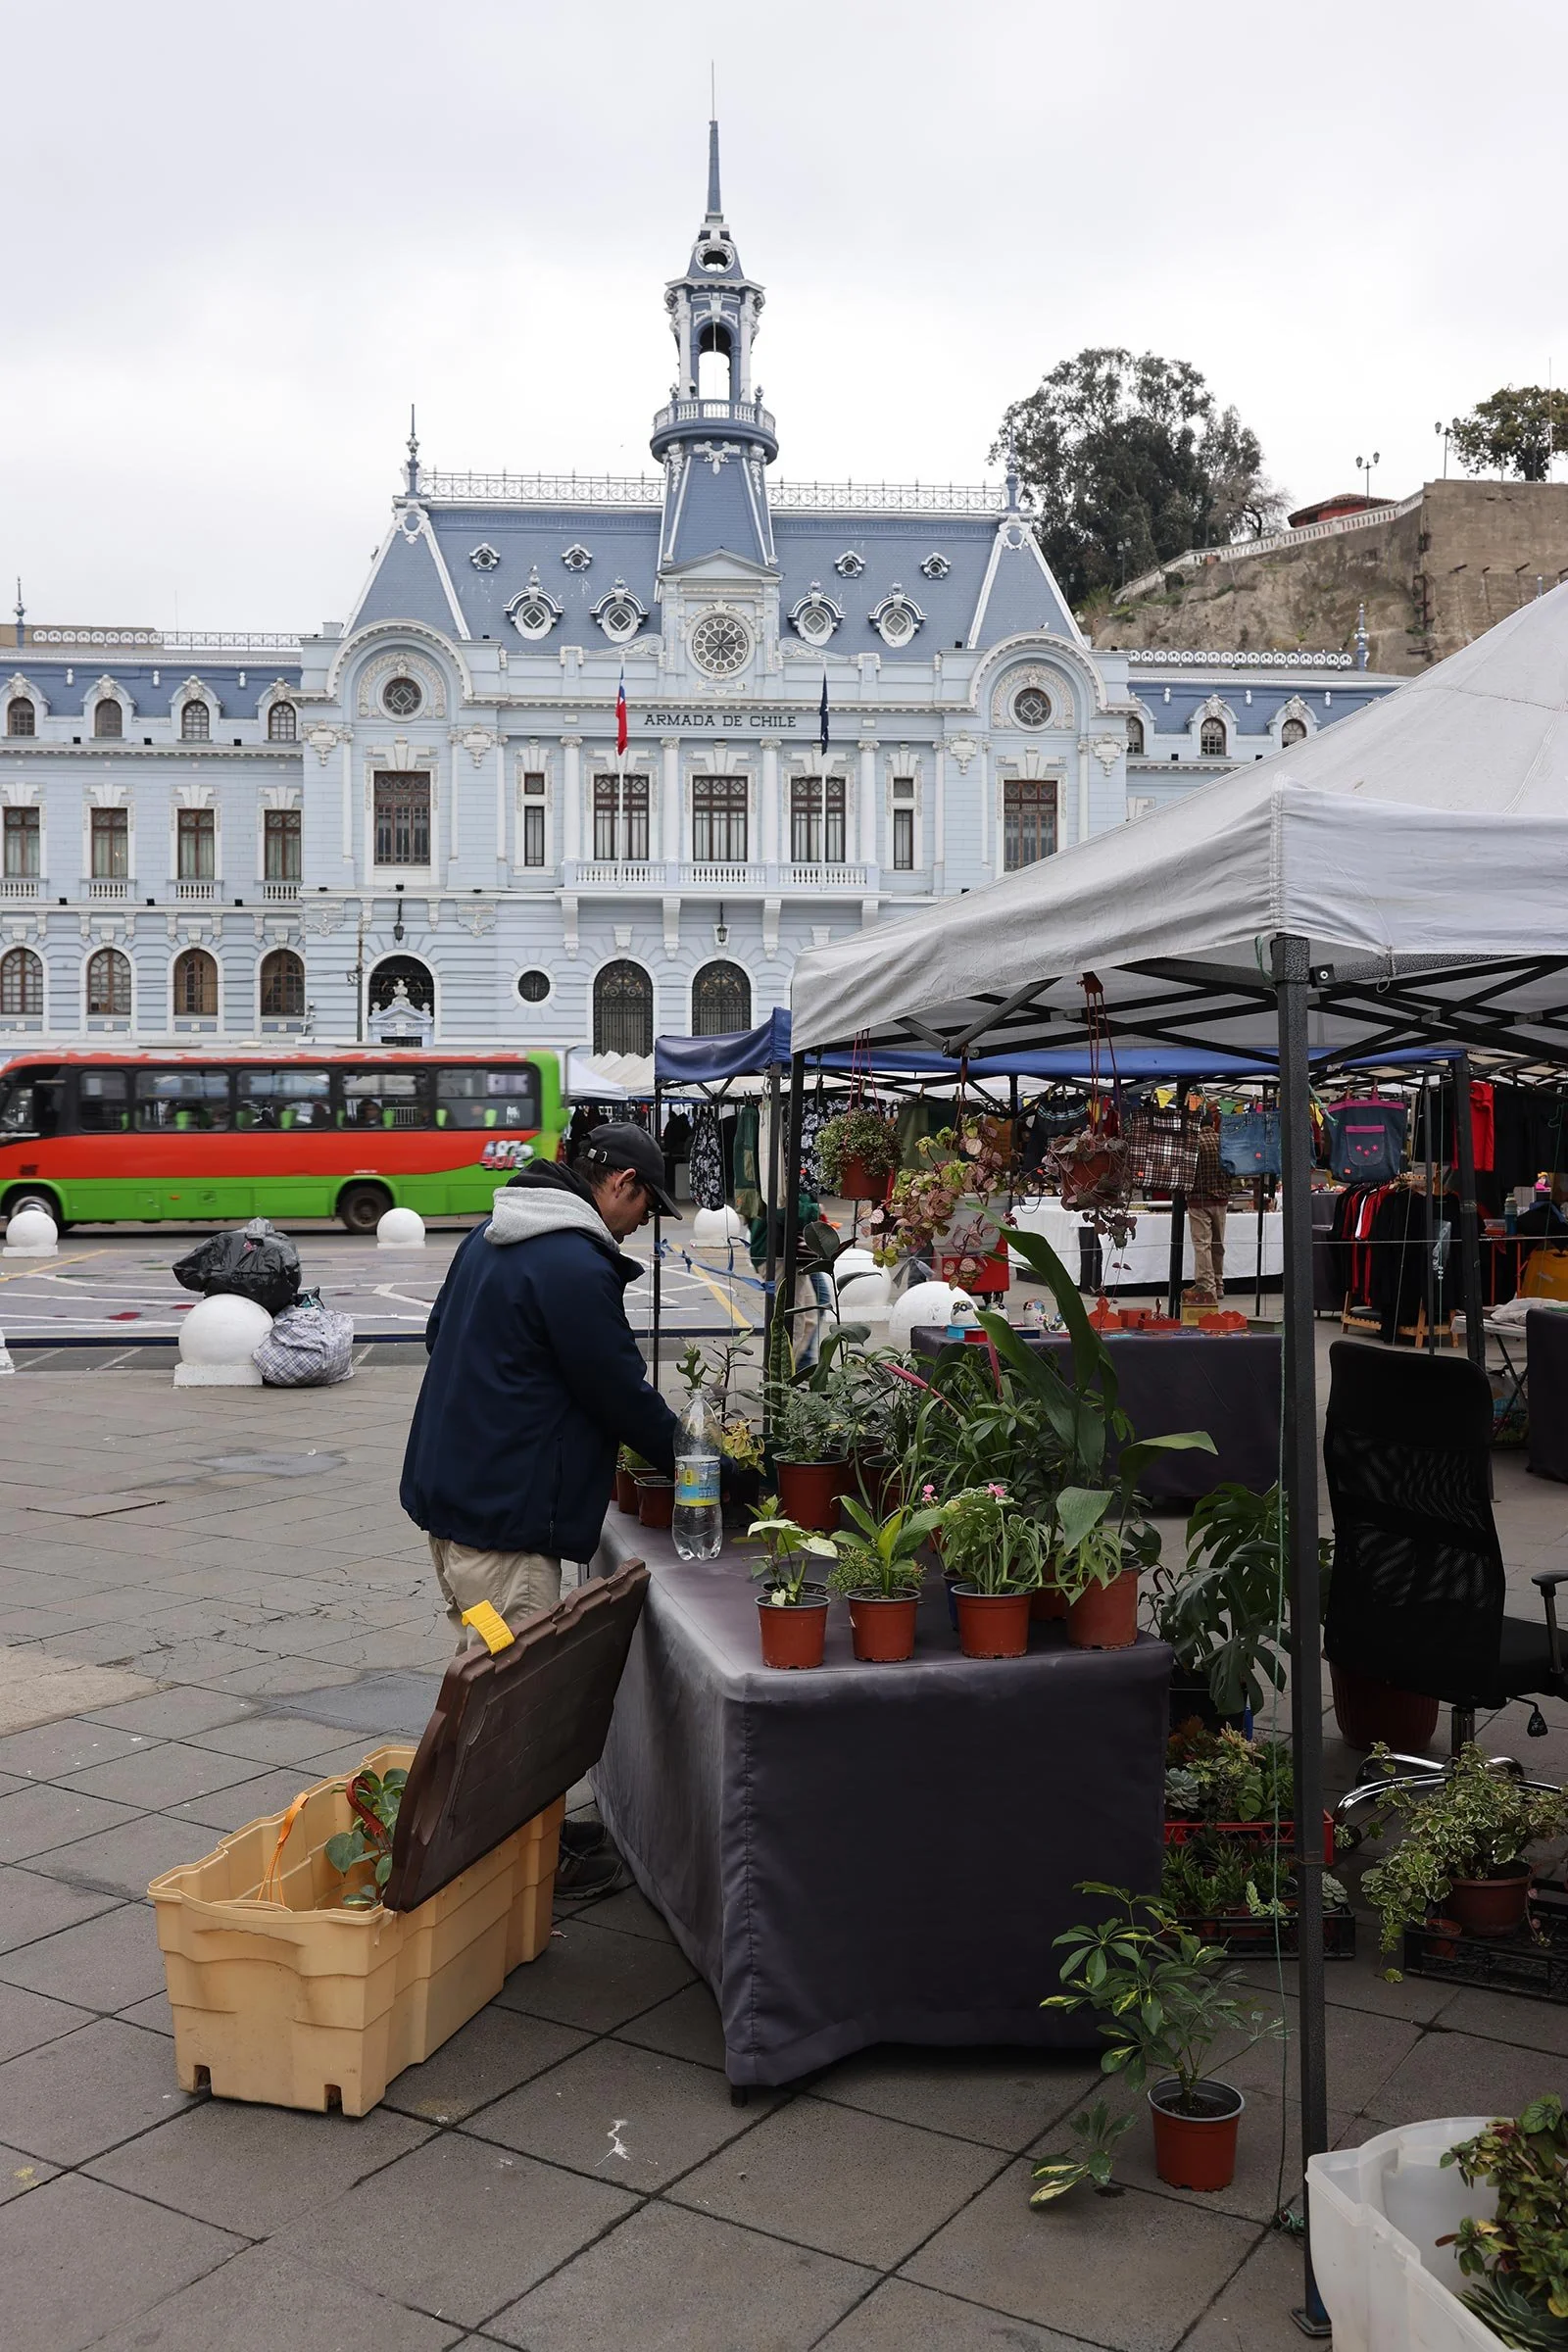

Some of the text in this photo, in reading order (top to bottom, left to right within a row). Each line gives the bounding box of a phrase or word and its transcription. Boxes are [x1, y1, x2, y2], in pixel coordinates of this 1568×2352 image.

[644, 713, 797, 728] ARMADA DE CHILE
